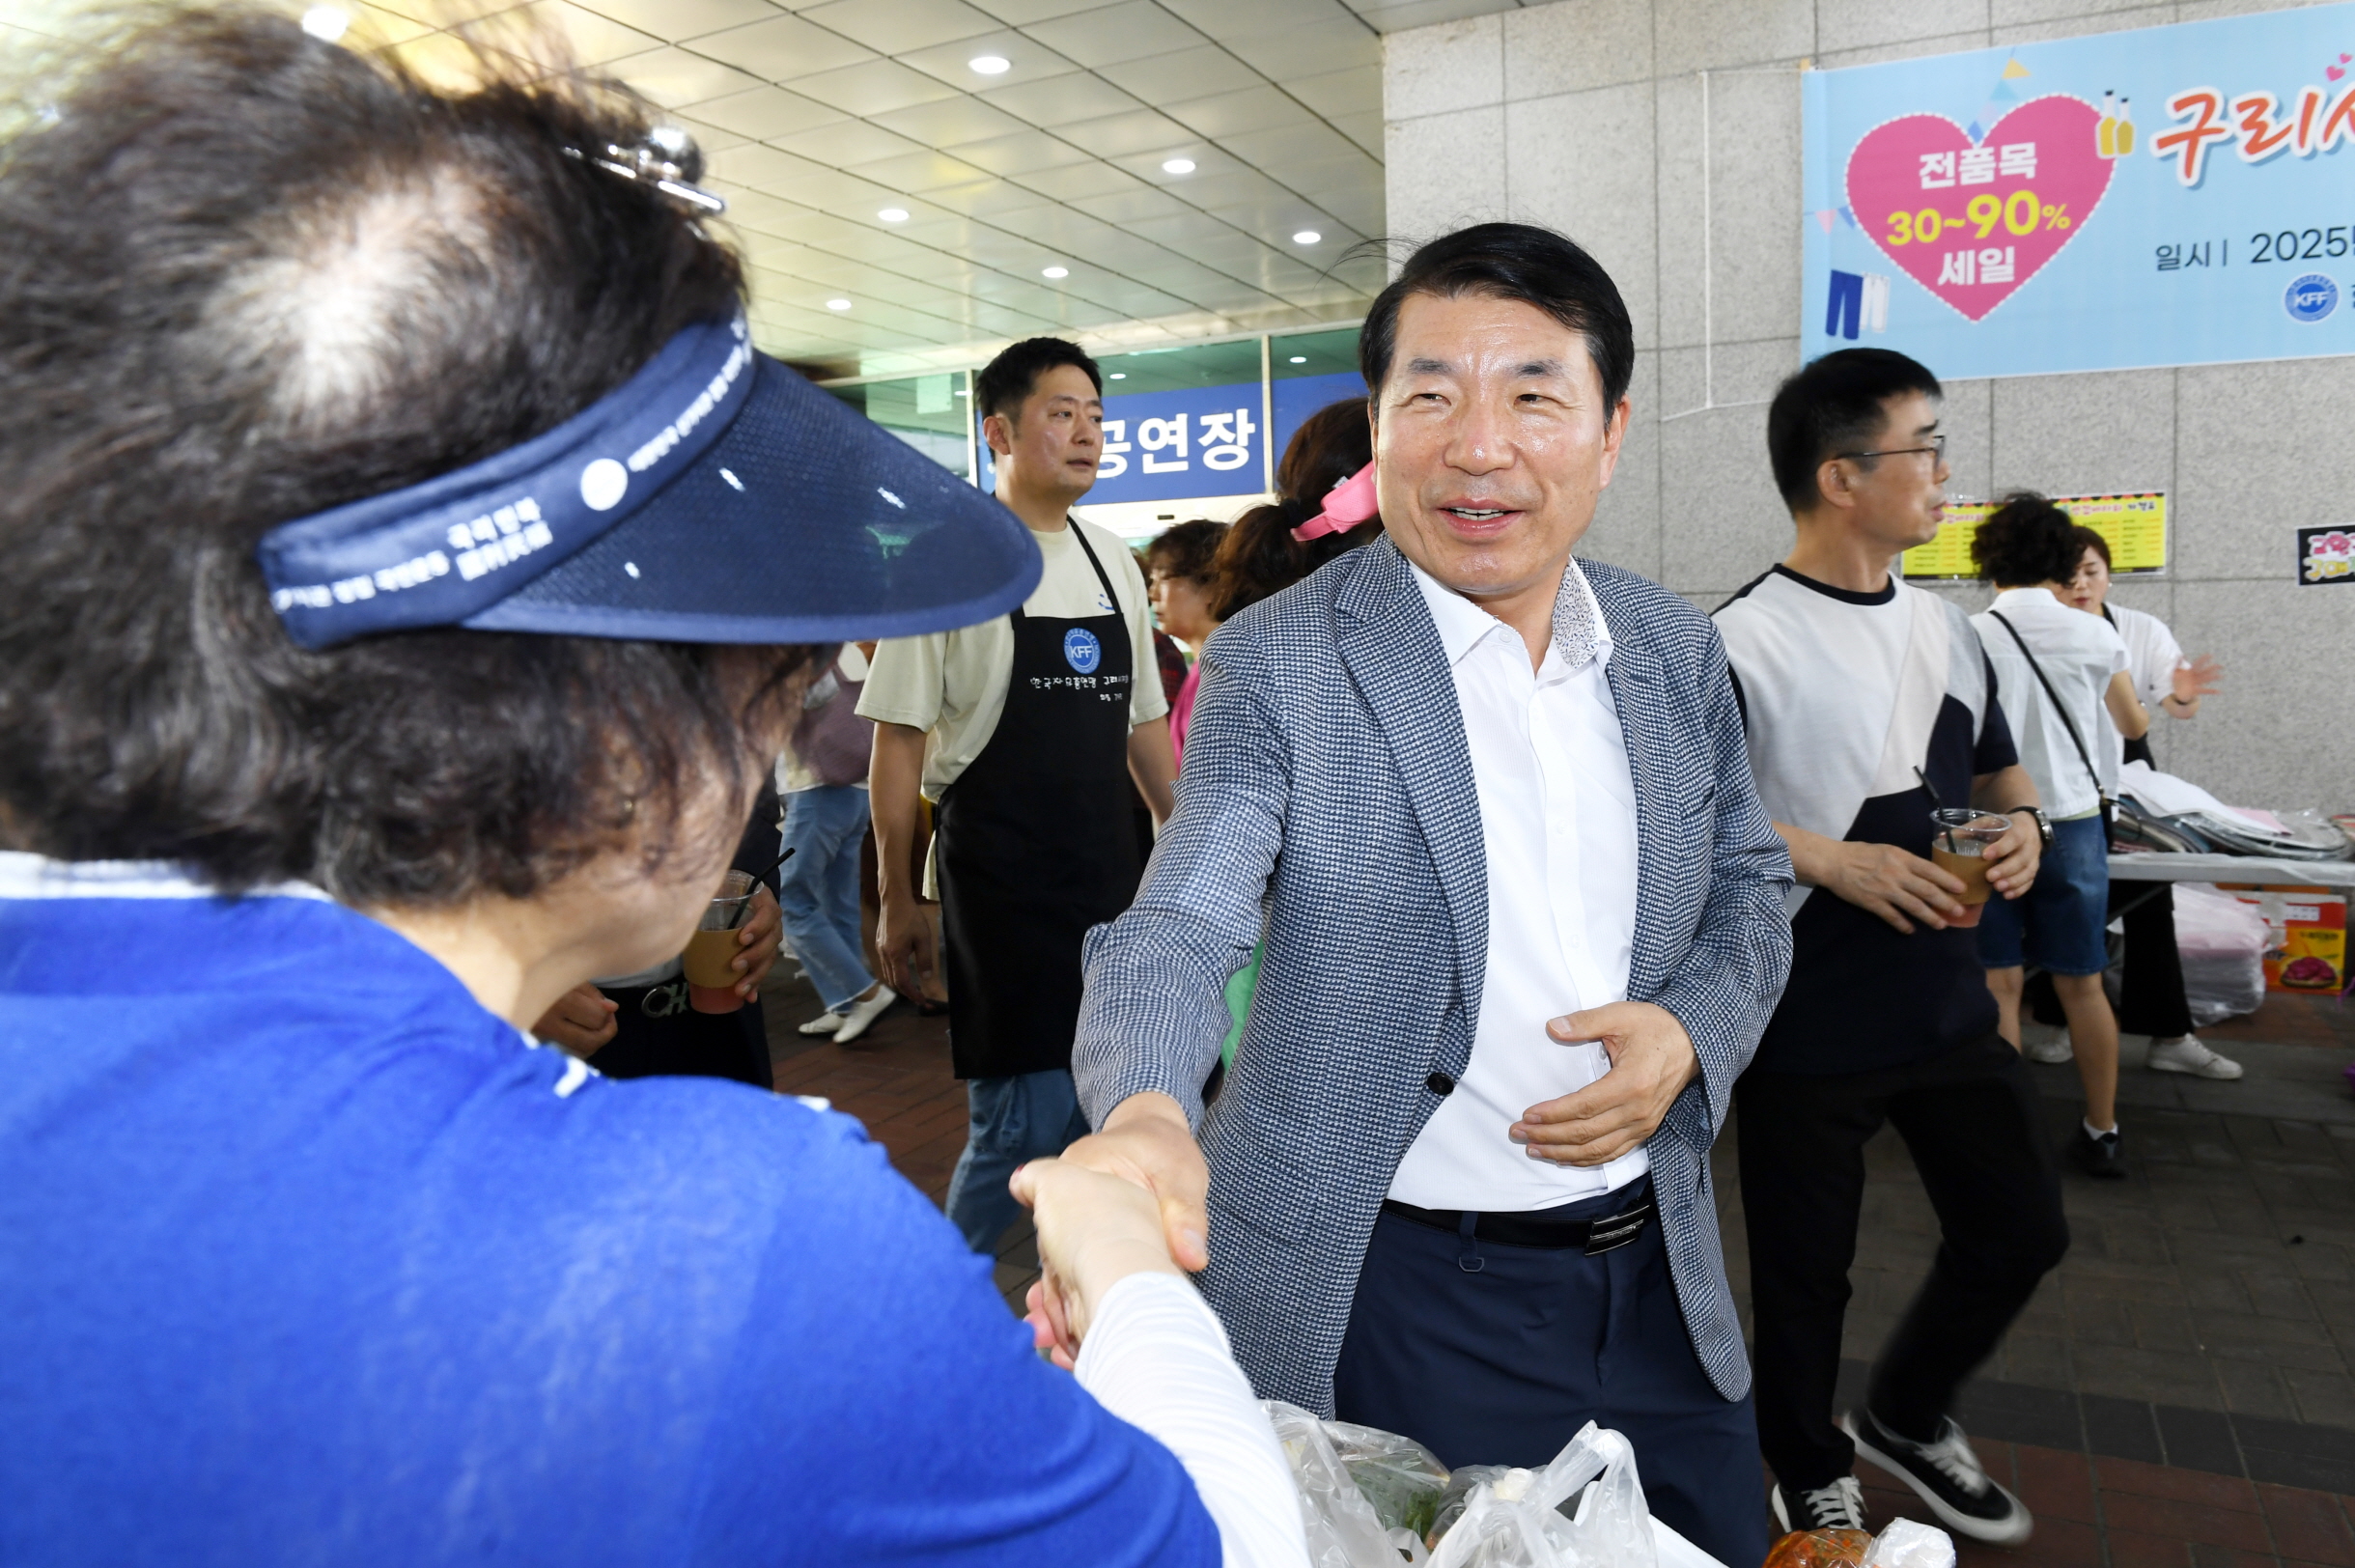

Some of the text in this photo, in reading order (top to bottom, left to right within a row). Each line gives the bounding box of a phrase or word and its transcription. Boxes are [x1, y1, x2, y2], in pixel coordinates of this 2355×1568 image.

[1919, 142, 2037, 189] 전품목
[1887, 189, 2071, 245] 30~90%
[2250, 225, 2355, 264] 2025
[1937, 245, 2015, 286] 세일
[2294, 290, 2330, 308] KFF
[1096, 408, 1255, 478] 공연장
[1069, 645, 1093, 658] KFF
